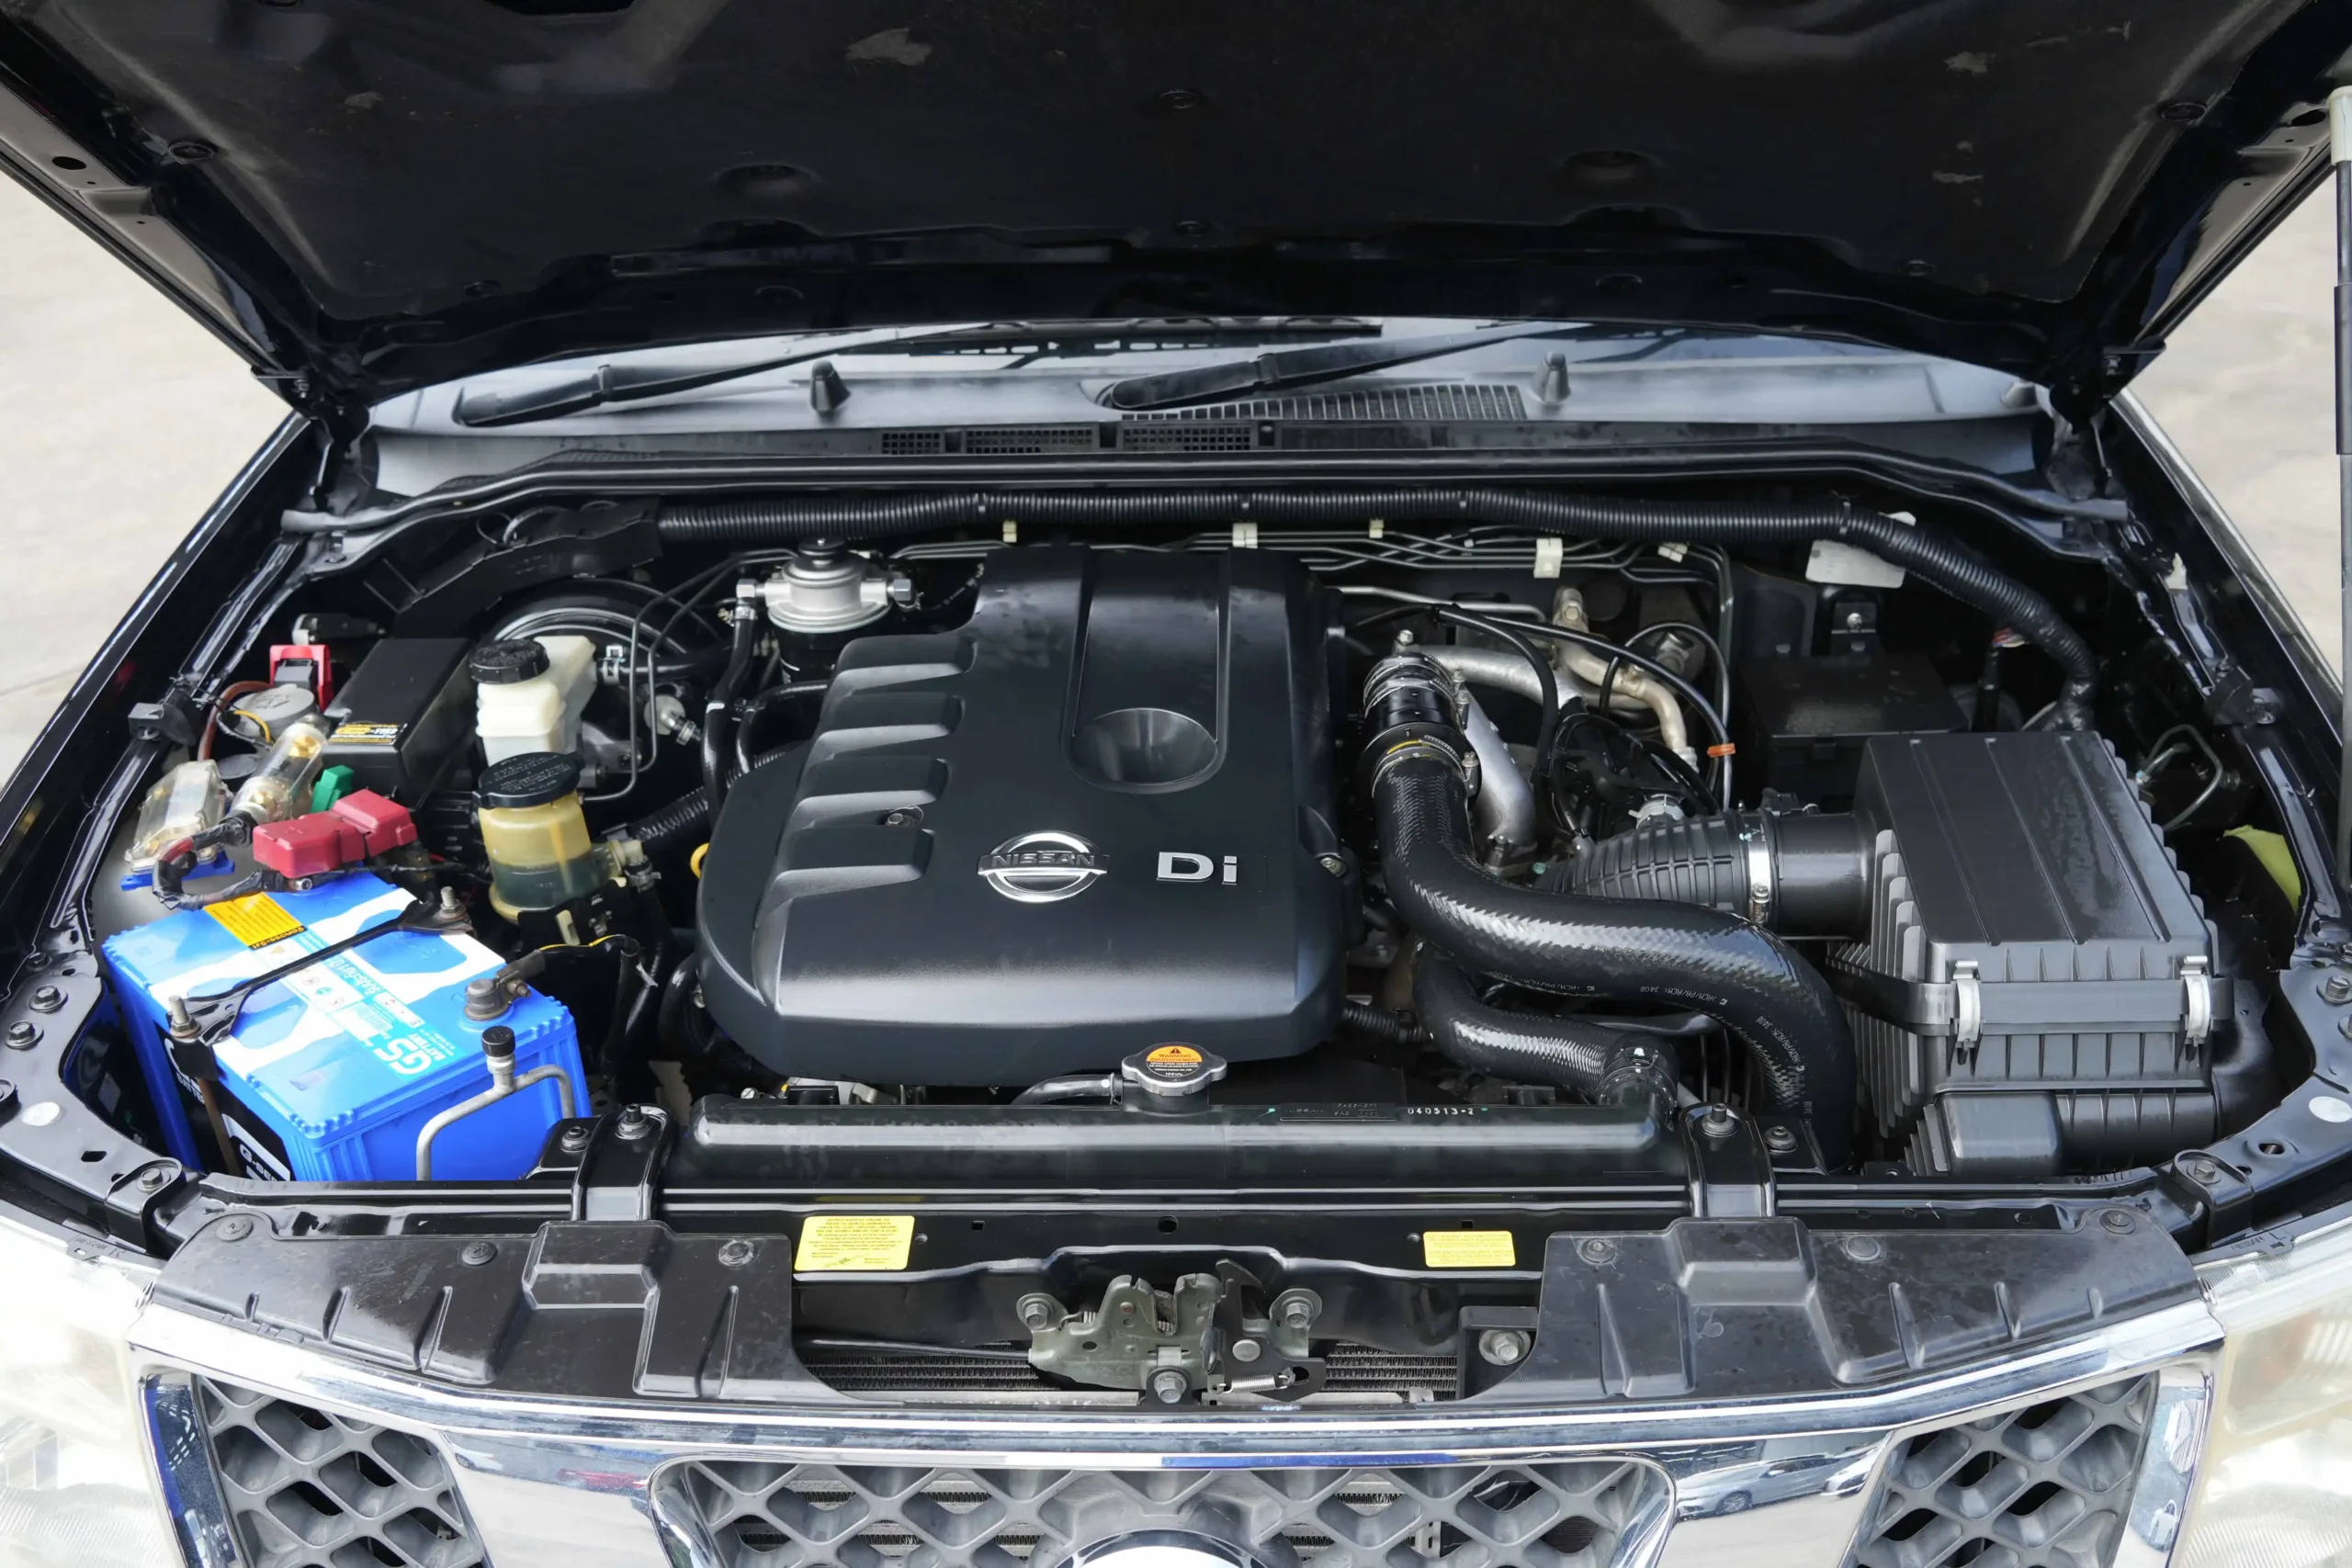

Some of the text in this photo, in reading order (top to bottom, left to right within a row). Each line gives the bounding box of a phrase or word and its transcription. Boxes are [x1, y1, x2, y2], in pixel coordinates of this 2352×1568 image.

[990, 852, 1095, 868] NISSAN
[1157, 852, 1238, 885] Di
[372, 1038, 432, 1075] GS
[175, 1072, 206, 1105] BATTE
